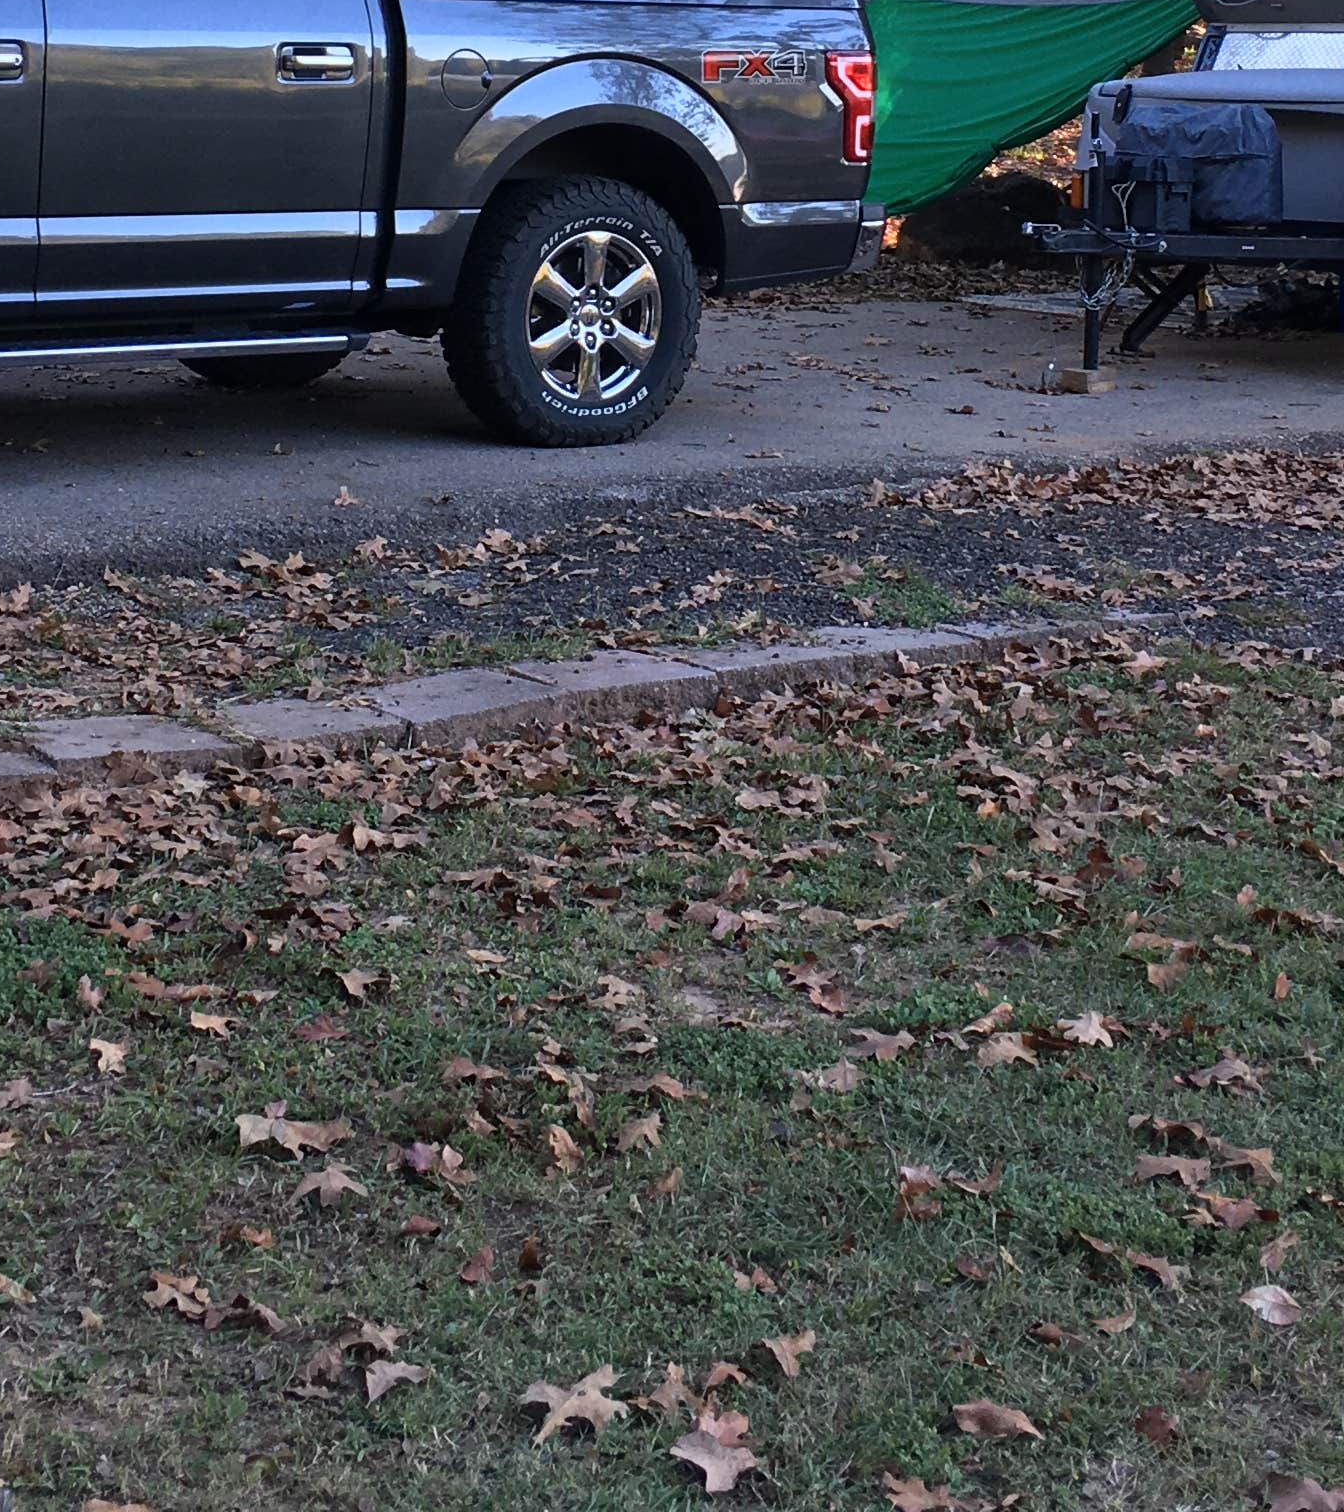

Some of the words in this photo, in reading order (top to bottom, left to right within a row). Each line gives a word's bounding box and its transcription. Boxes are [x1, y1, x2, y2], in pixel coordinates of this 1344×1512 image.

[701, 49, 807, 84] FX4
[540, 217, 635, 259] All-Terrain
[639, 229, 663, 257] T/A
[541, 386, 649, 416] BFGoodrich
